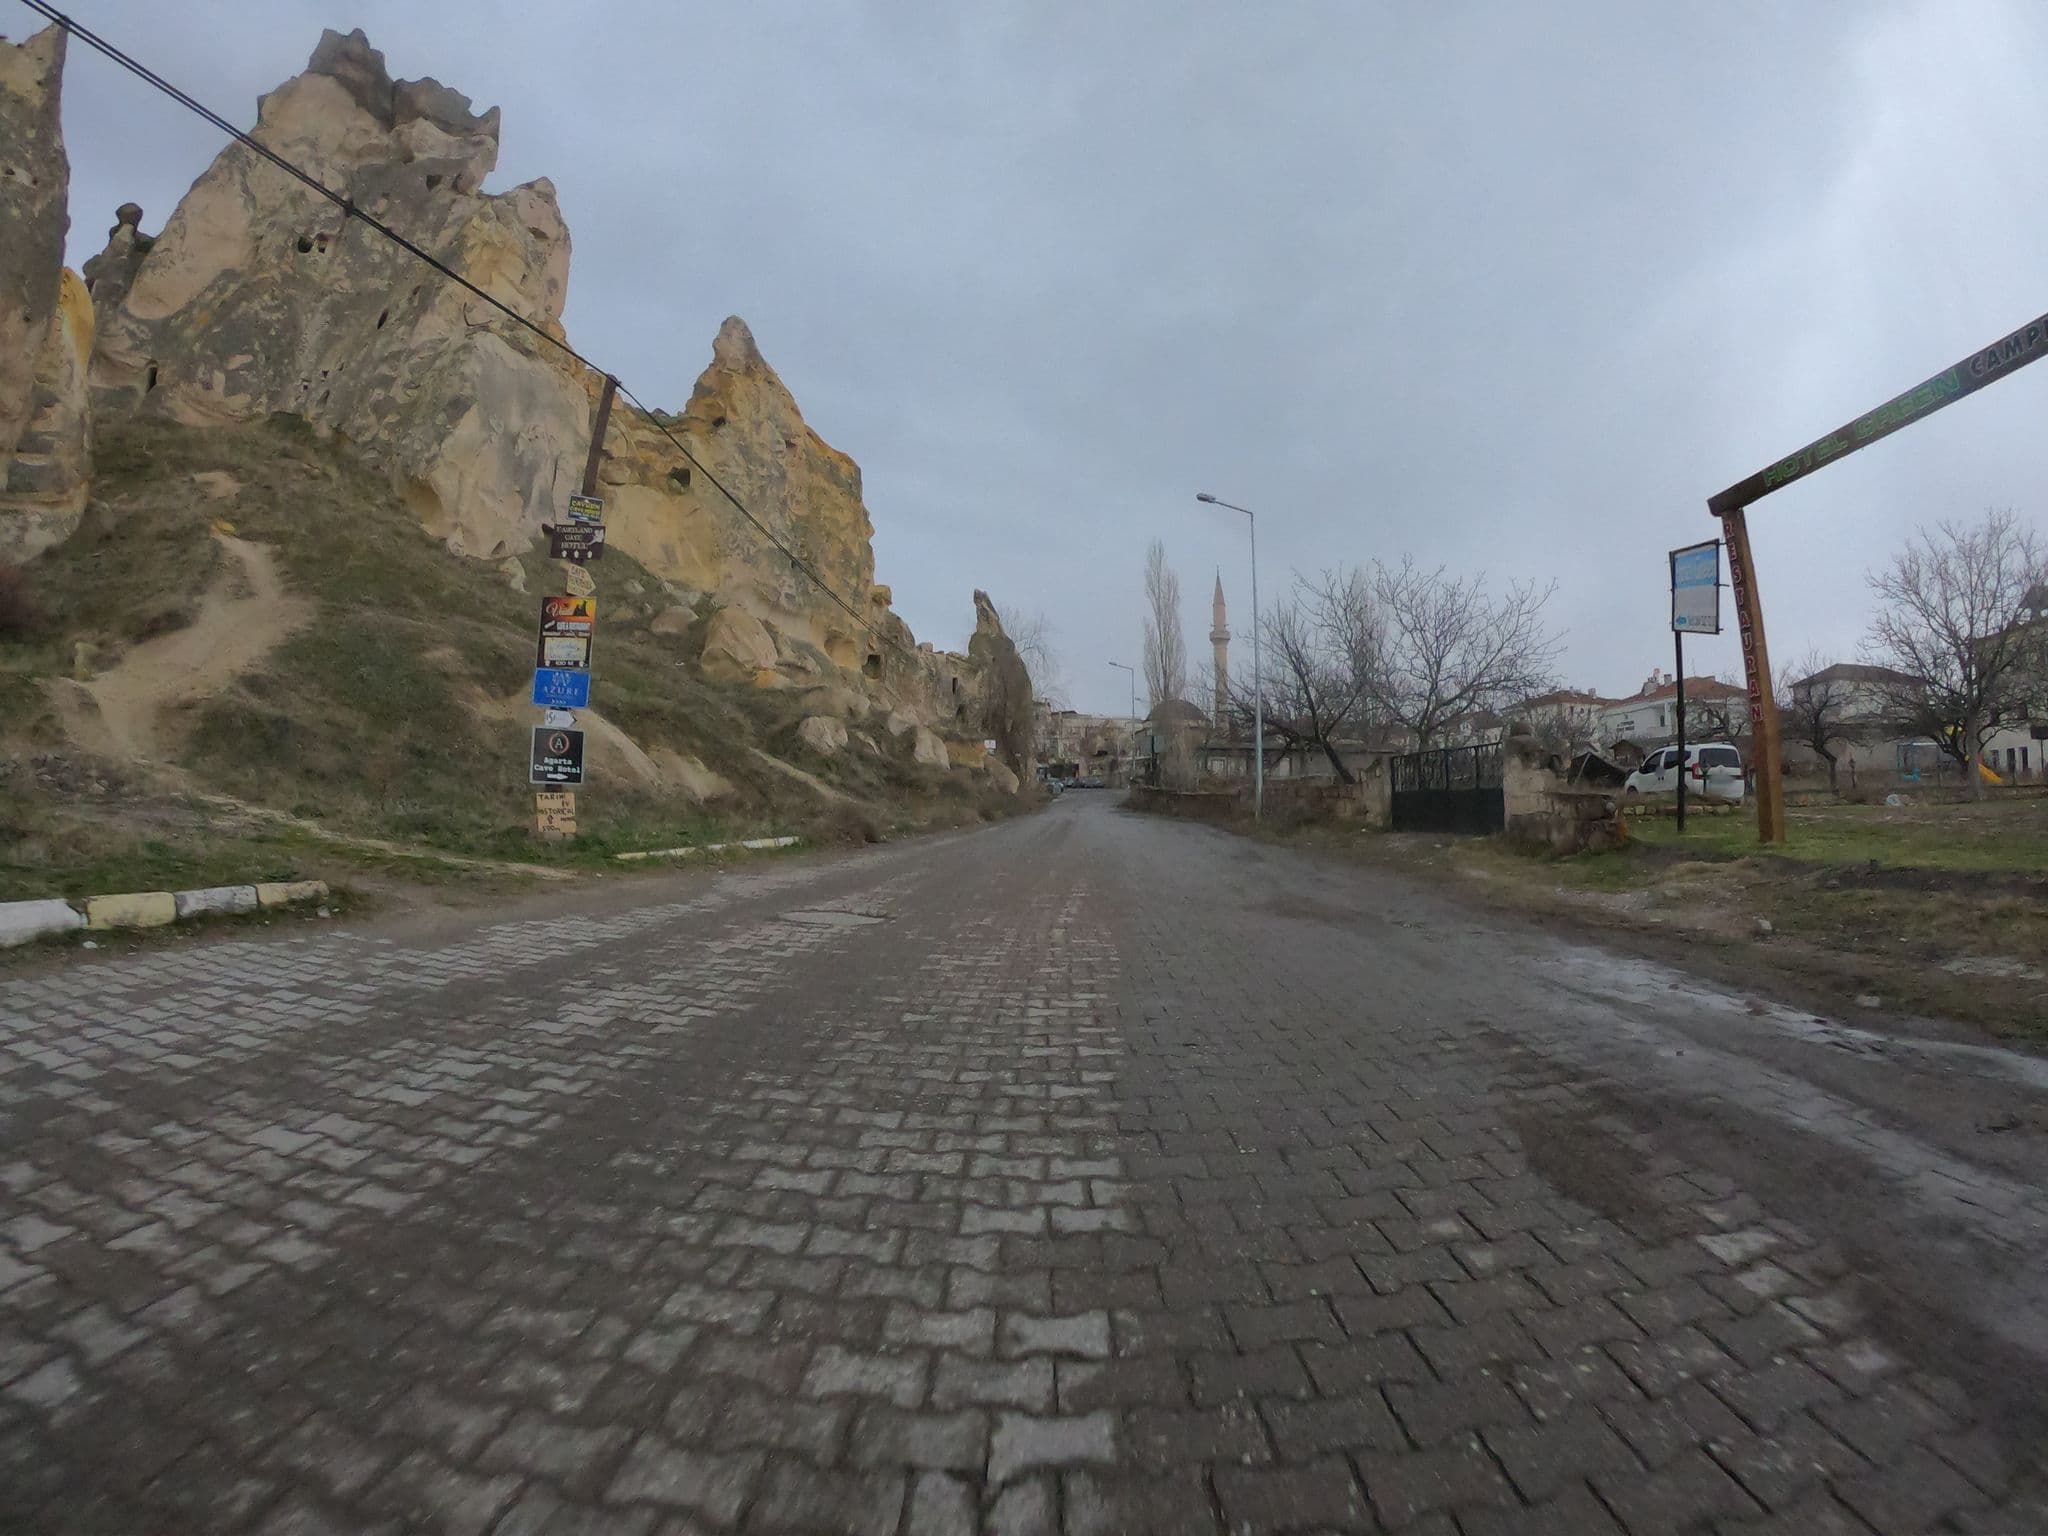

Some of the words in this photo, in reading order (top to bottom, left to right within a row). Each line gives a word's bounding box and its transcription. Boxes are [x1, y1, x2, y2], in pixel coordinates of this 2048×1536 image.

[1763, 435, 1848, 487] HOTEL
[1853, 367, 1961, 440] GREEN
[561, 541, 588, 550] HOTEL
[558, 765, 581, 774] Hotel
